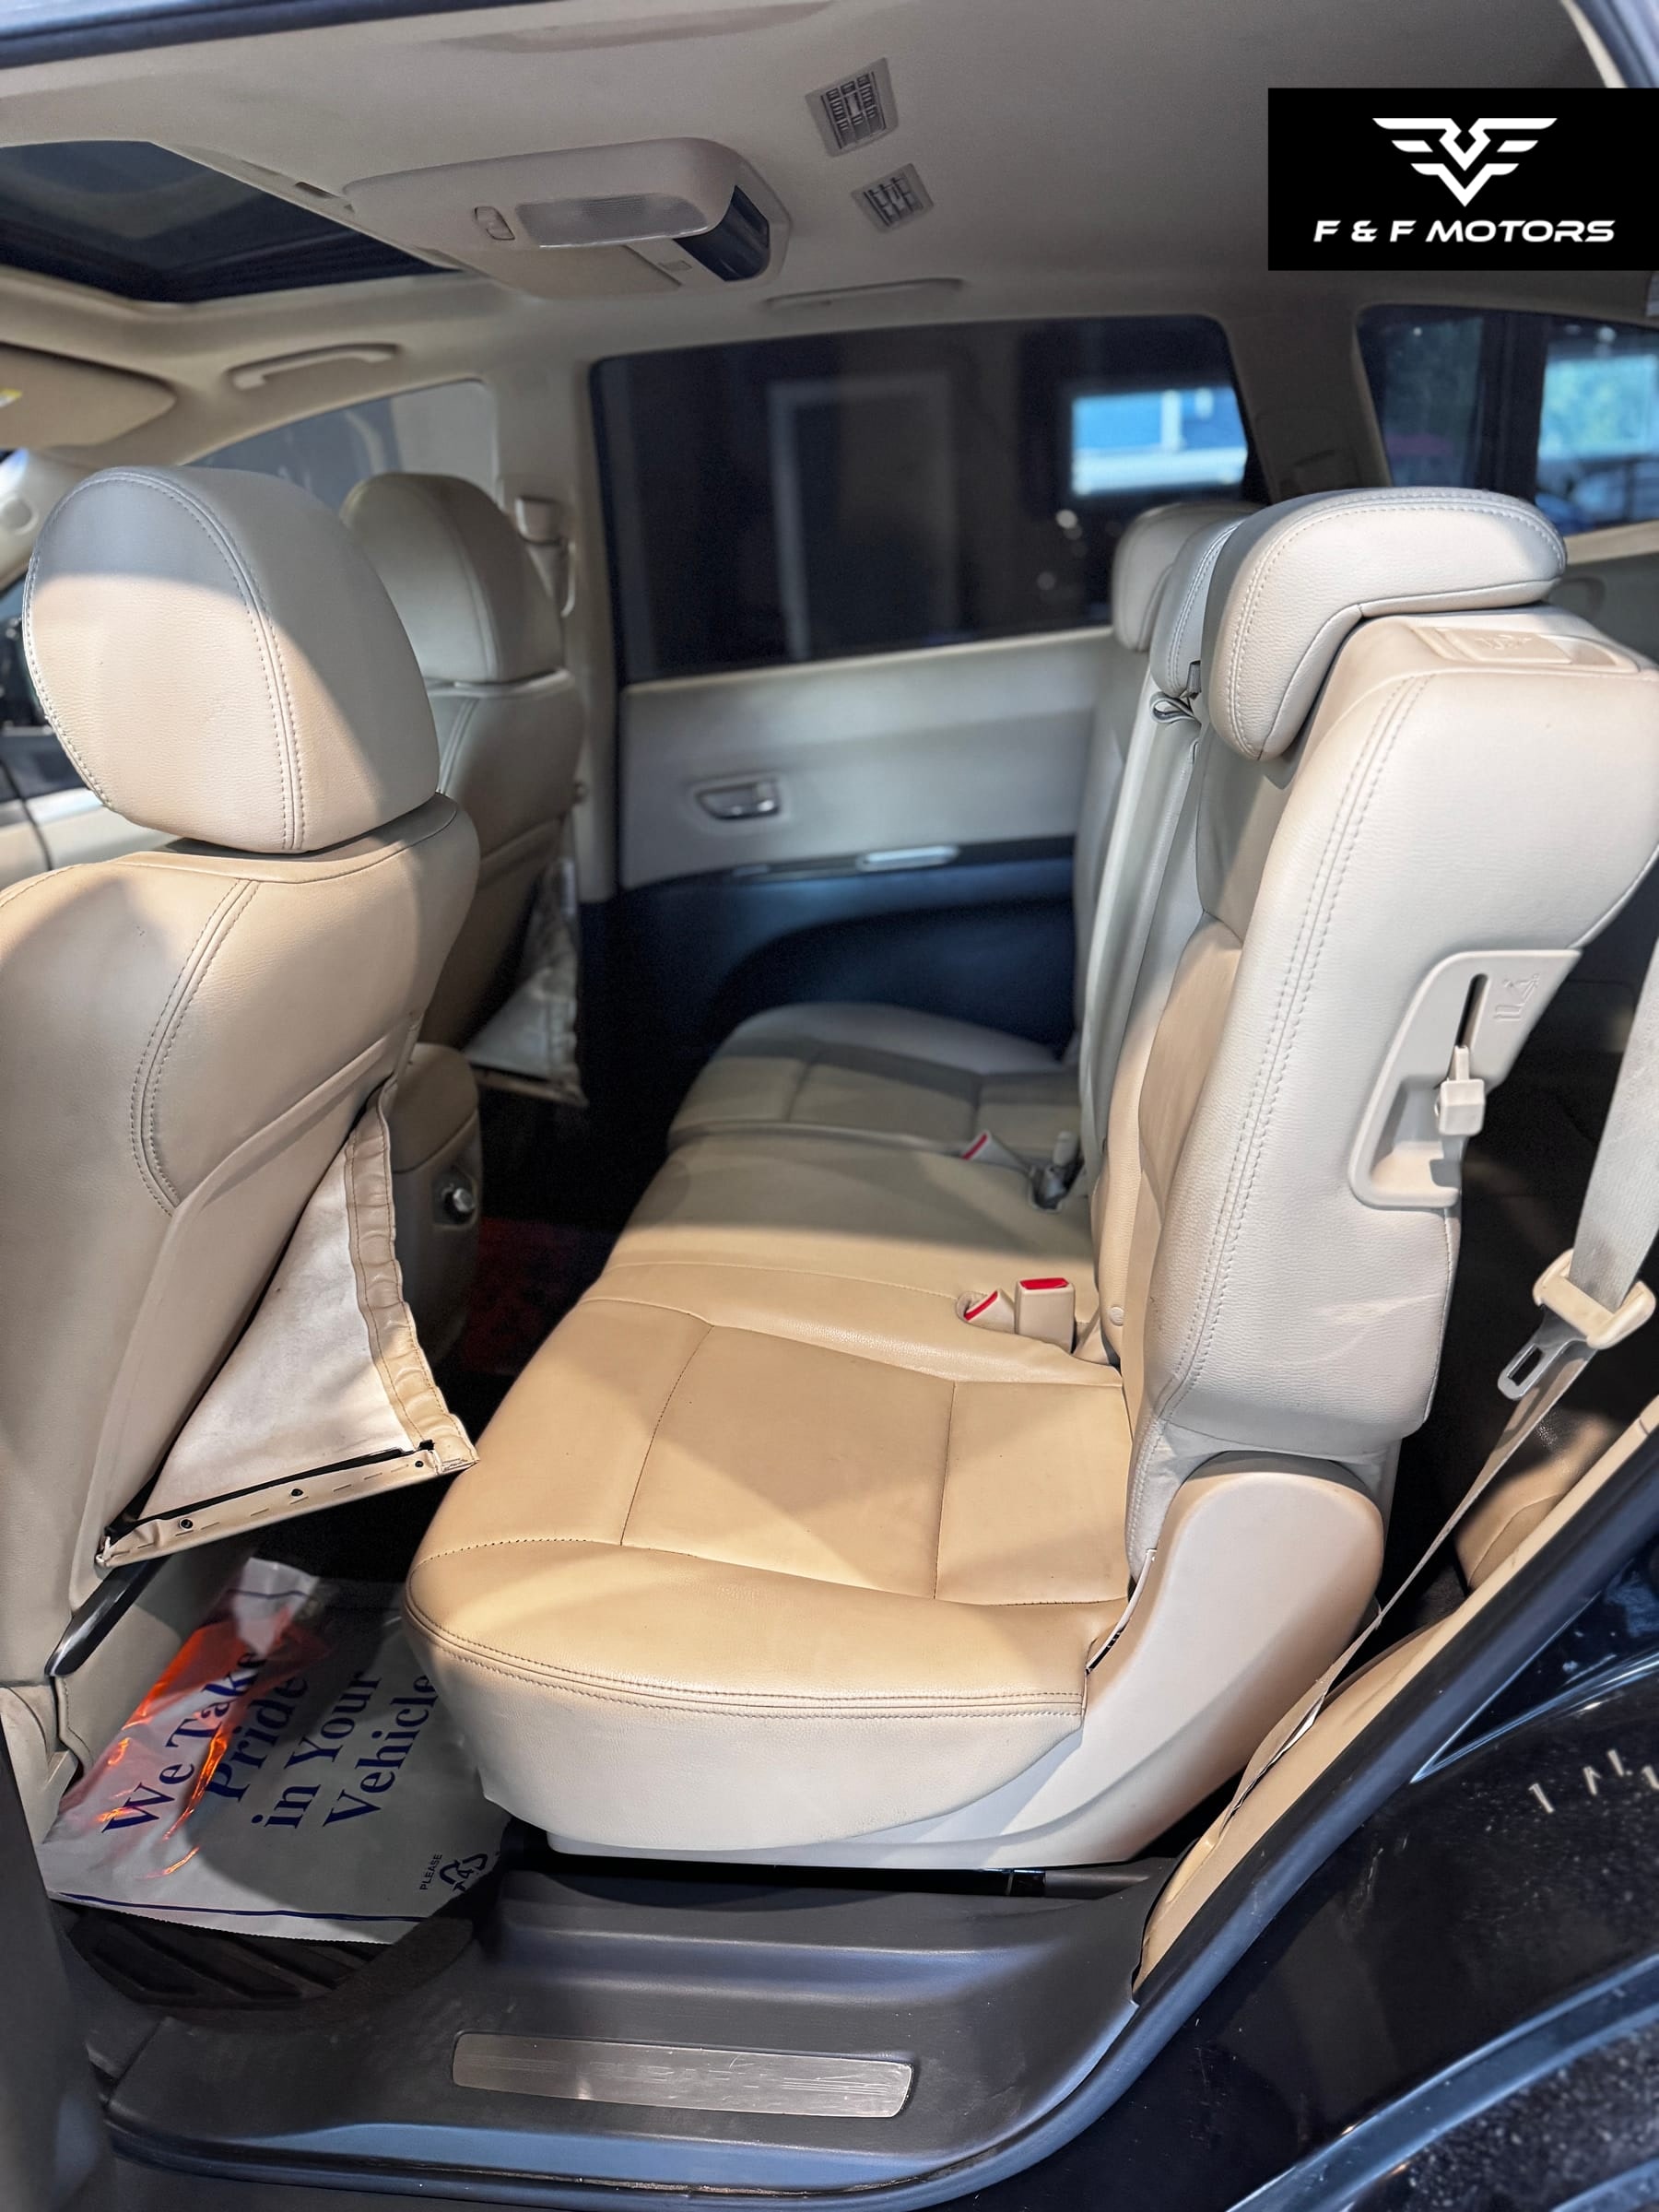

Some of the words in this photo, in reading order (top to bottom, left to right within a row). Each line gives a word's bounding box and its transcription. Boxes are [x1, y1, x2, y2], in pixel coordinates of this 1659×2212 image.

[101, 1763, 195, 1833] We
[165, 1653, 267, 1747] Take
[206, 1676, 310, 1803] Pride
[284, 1671, 382, 1770] Your
[323, 1675, 439, 1827] Vehicle
[251, 1784, 322, 1830] in
[419, 1853, 443, 1890] PLEASE
